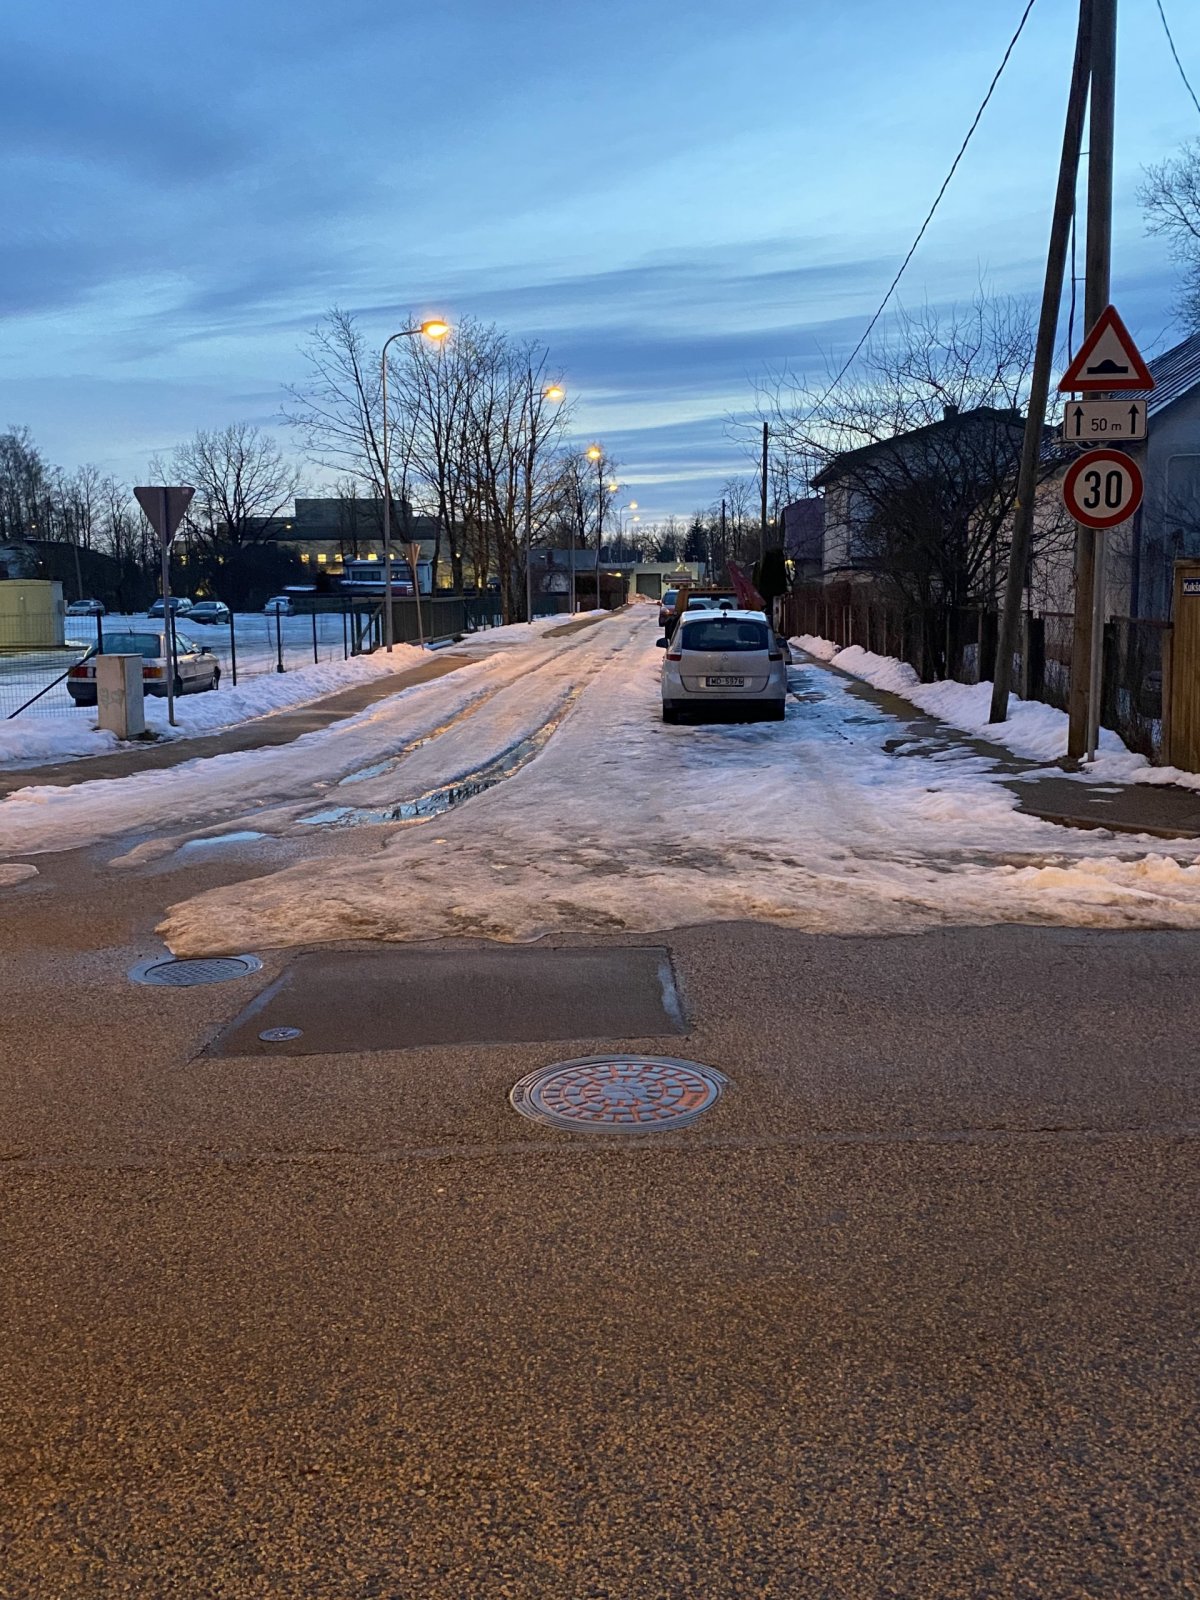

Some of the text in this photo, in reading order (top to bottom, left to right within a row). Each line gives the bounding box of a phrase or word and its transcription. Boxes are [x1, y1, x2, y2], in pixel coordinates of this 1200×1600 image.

[1091, 418, 1122, 431] 50 m
[1084, 470, 1122, 508] 30
